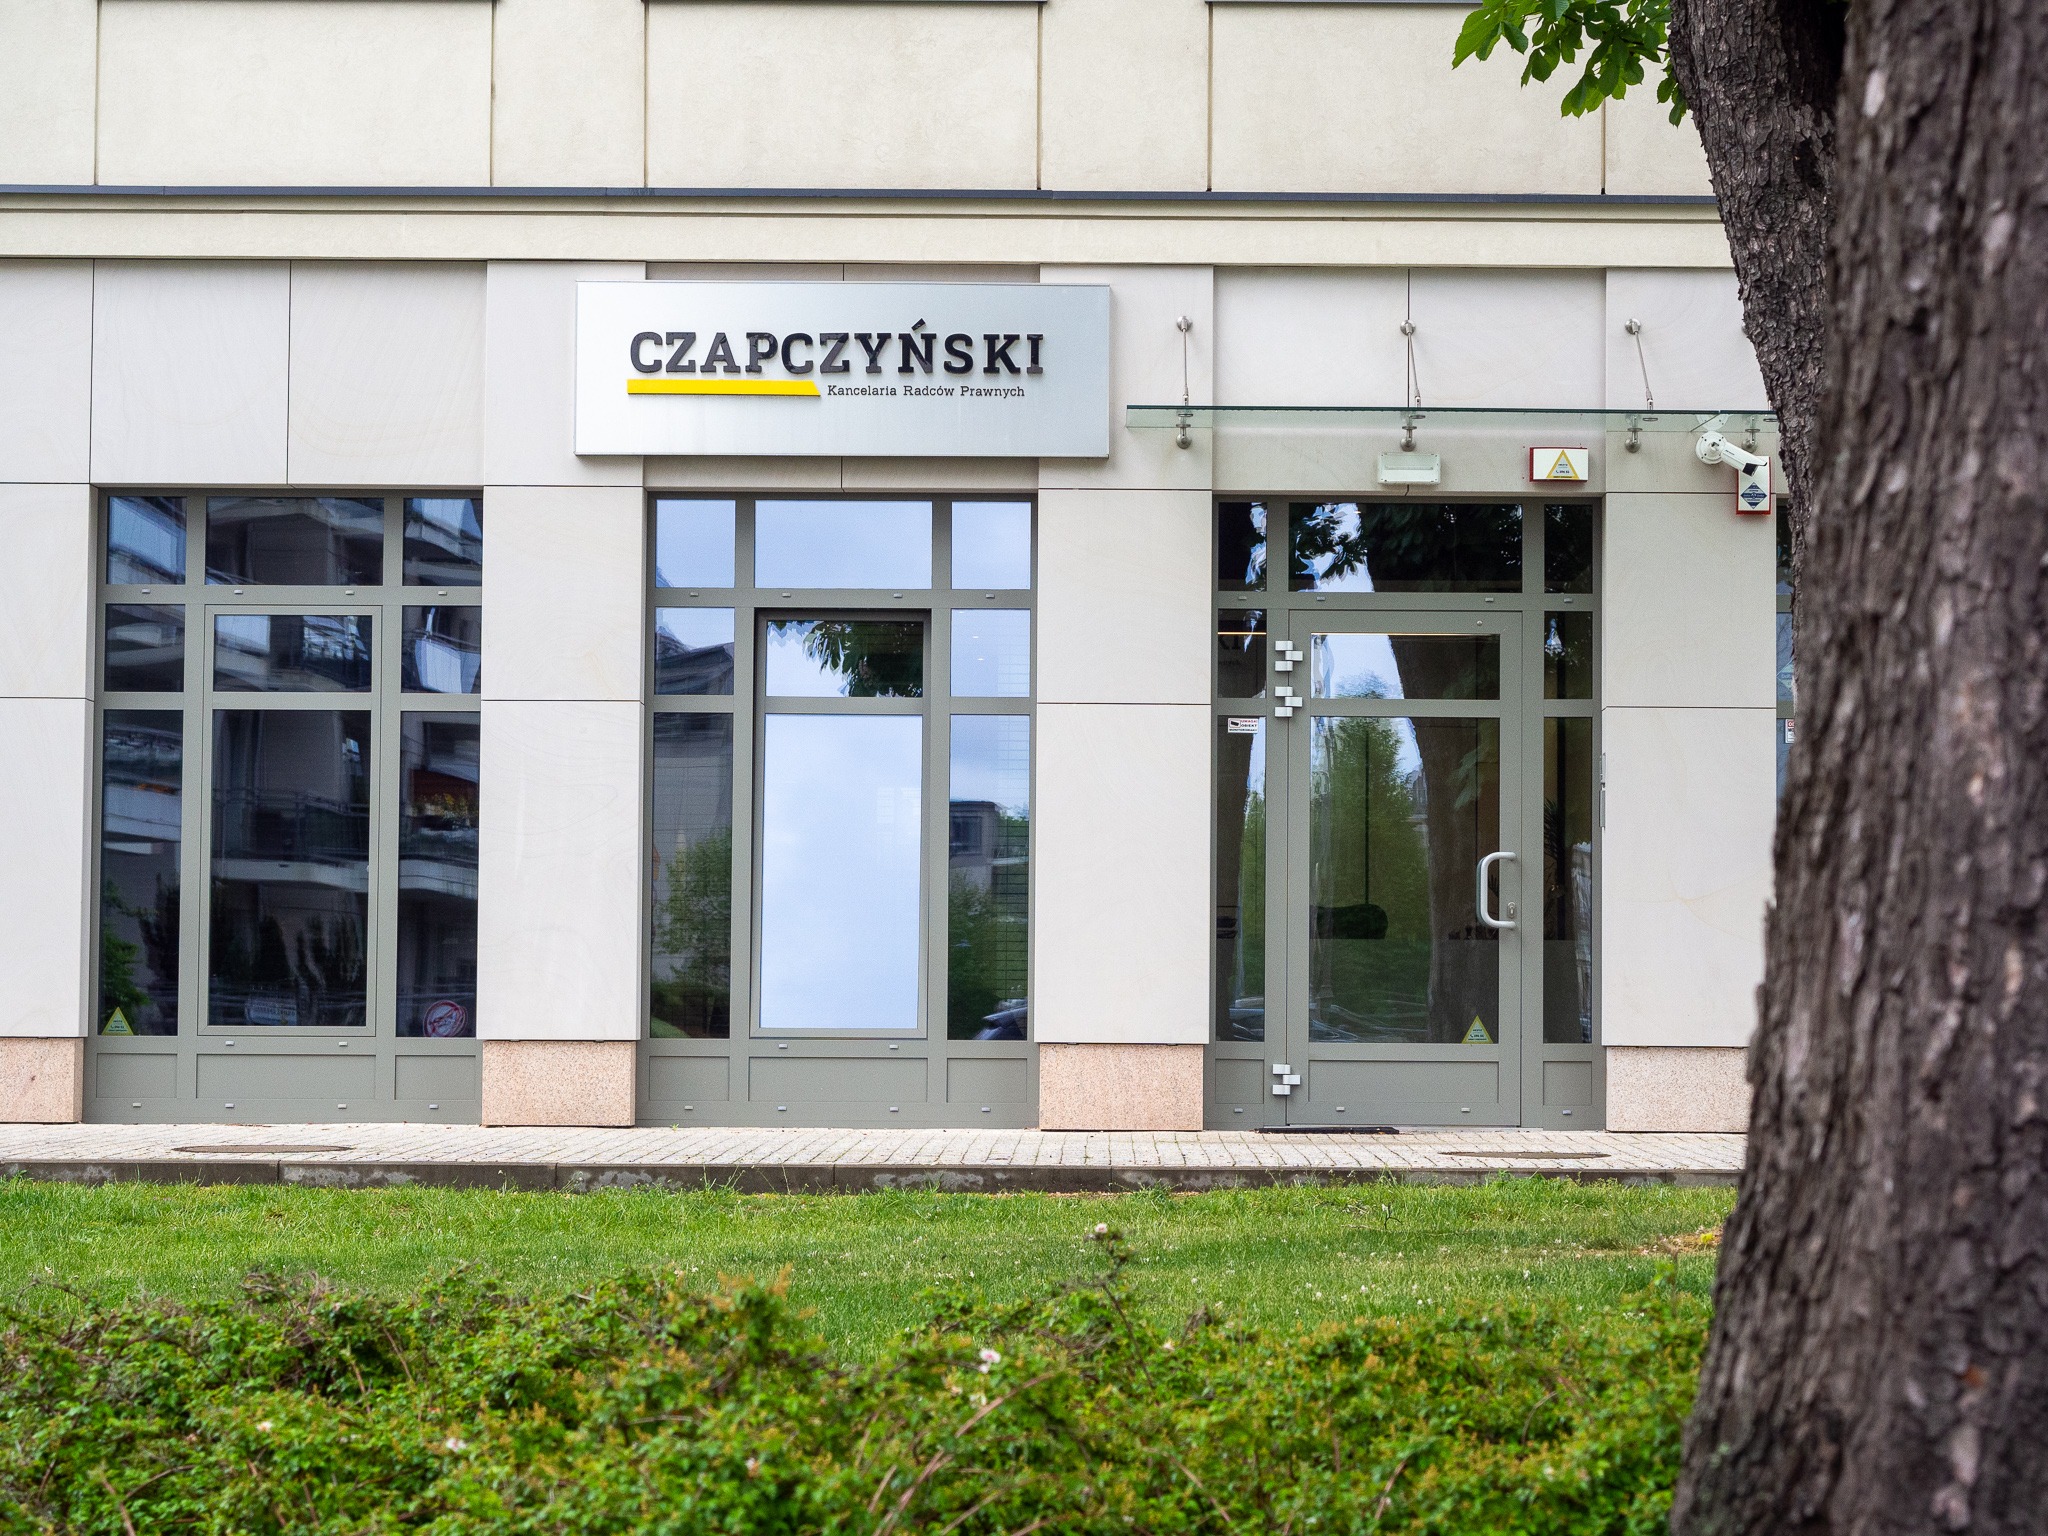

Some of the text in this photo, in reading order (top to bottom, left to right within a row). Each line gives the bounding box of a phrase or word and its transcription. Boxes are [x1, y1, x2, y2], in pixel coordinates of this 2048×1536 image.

[630, 318, 1044, 375] CZAPCZYŃSKI
[827, 385, 1025, 399] Kancelaria Radców Prawnych
